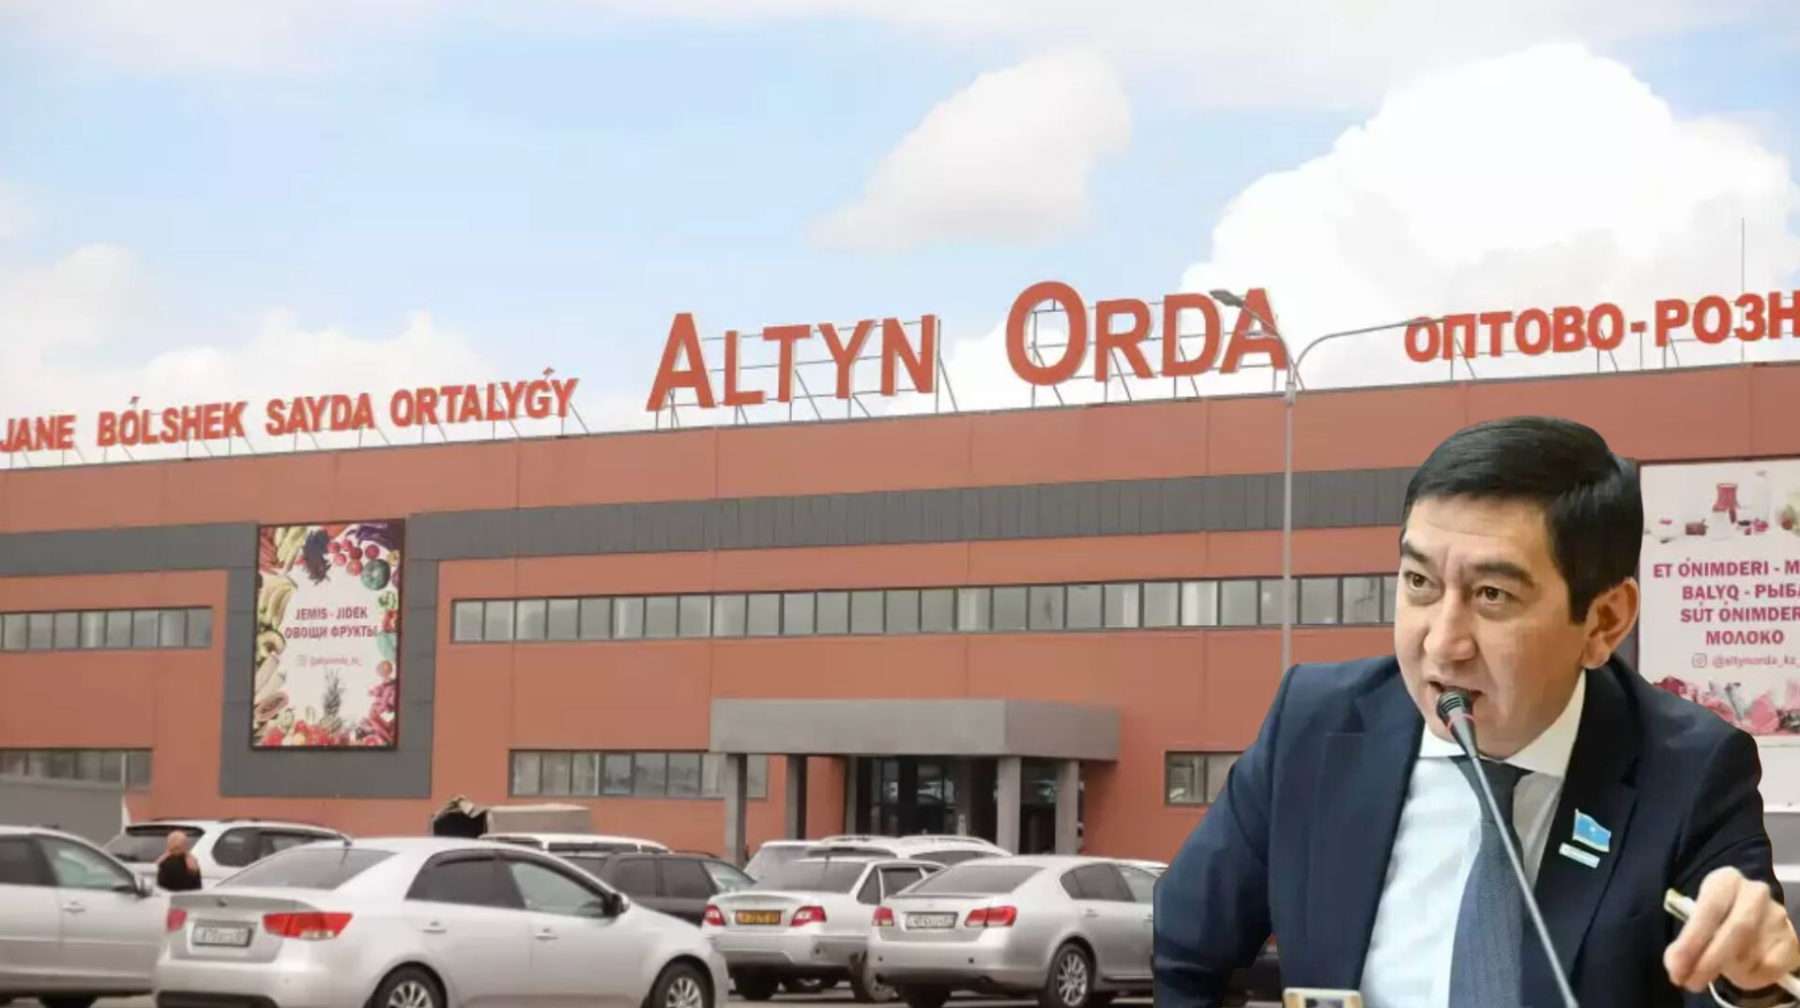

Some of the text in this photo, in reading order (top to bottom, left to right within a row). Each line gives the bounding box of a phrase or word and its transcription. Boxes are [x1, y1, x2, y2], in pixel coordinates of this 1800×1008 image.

[647, 281, 1288, 412] ALTYN ORDA
[0, 414, 76, 453] JANE
[96, 397, 248, 447] BÓLSHEK
[265, 393, 376, 436] SAYDA
[1653, 563, 1672, 578] ET
[1682, 584, 1740, 601] BALYQ
[295, 607, 328, 620] JEMIS
[336, 606, 368, 619] JIDEK
[285, 625, 378, 640] ОВОЩИ ФРУКТЫ
[1705, 630, 1785, 646] МОЛОКО
